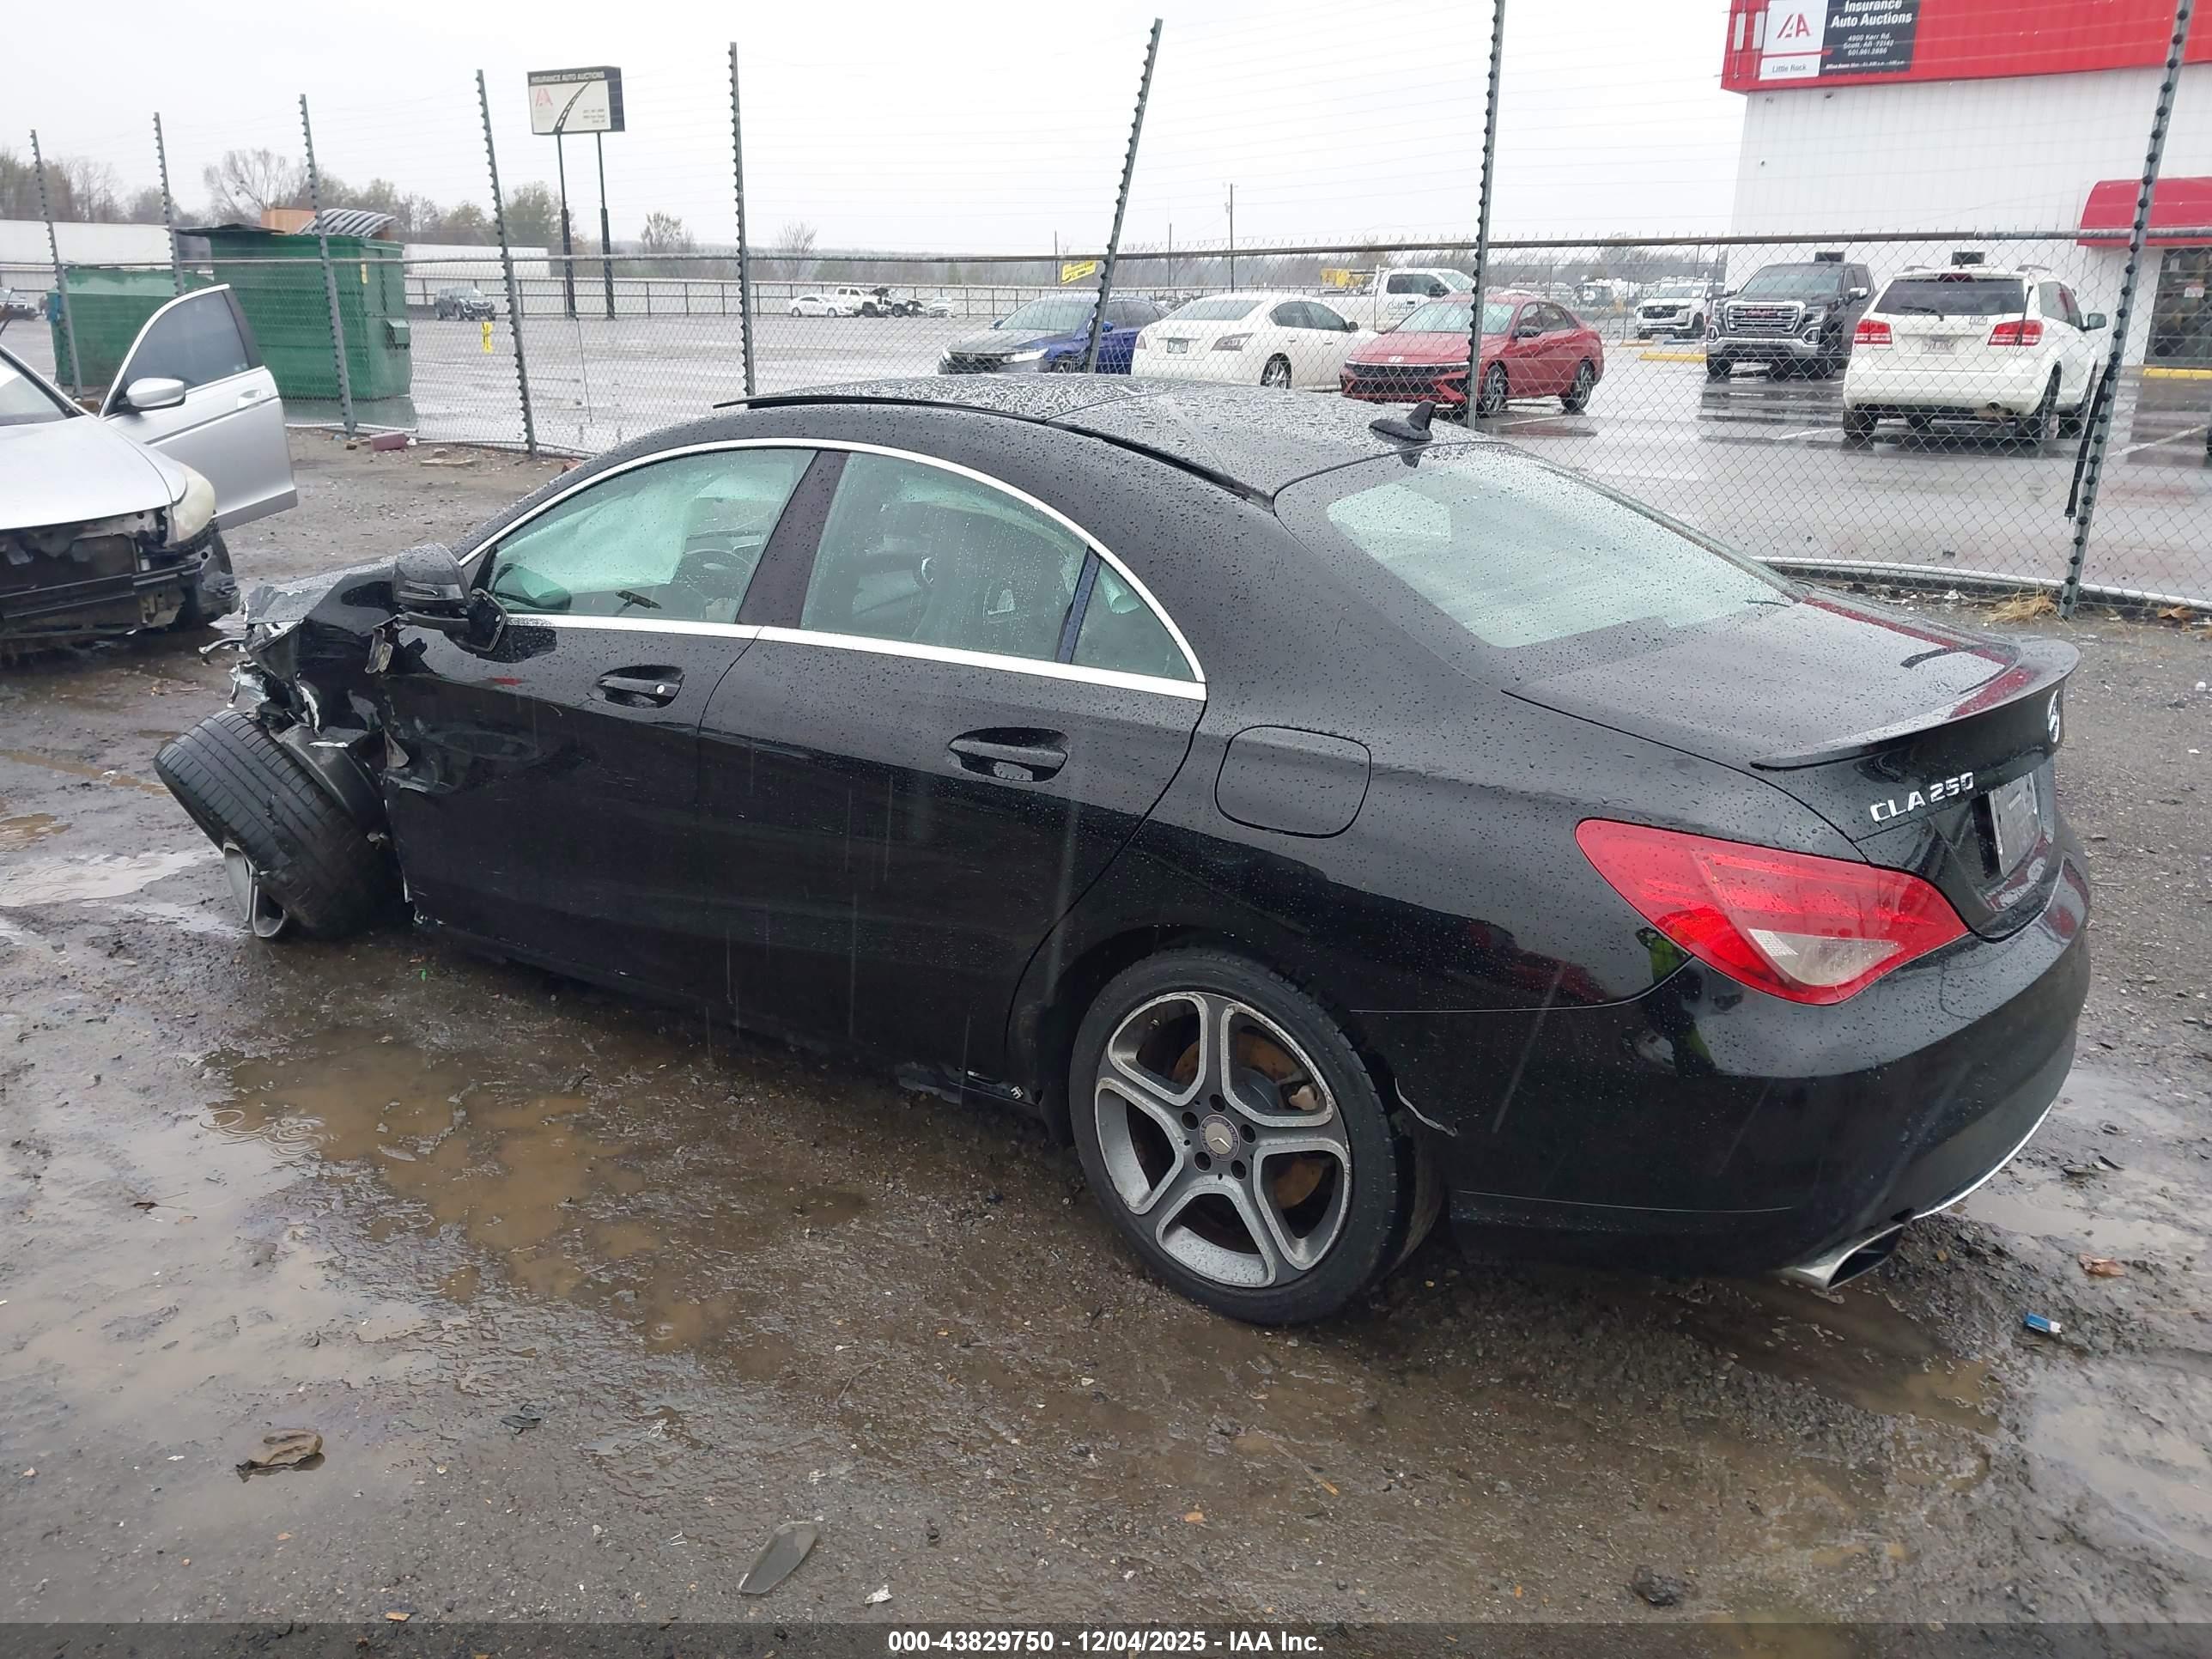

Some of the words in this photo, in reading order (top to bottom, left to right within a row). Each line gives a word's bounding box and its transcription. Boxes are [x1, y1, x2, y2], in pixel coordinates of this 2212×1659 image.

[1844, 0, 1902, 13] Insurance
[1831, 15, 1858, 27] Auto
[1860, 11, 1913, 27] Auctions
[1771, 65, 1789, 74] Little
[1870, 790, 1926, 822] CLA
[1929, 771, 1974, 804] 250
